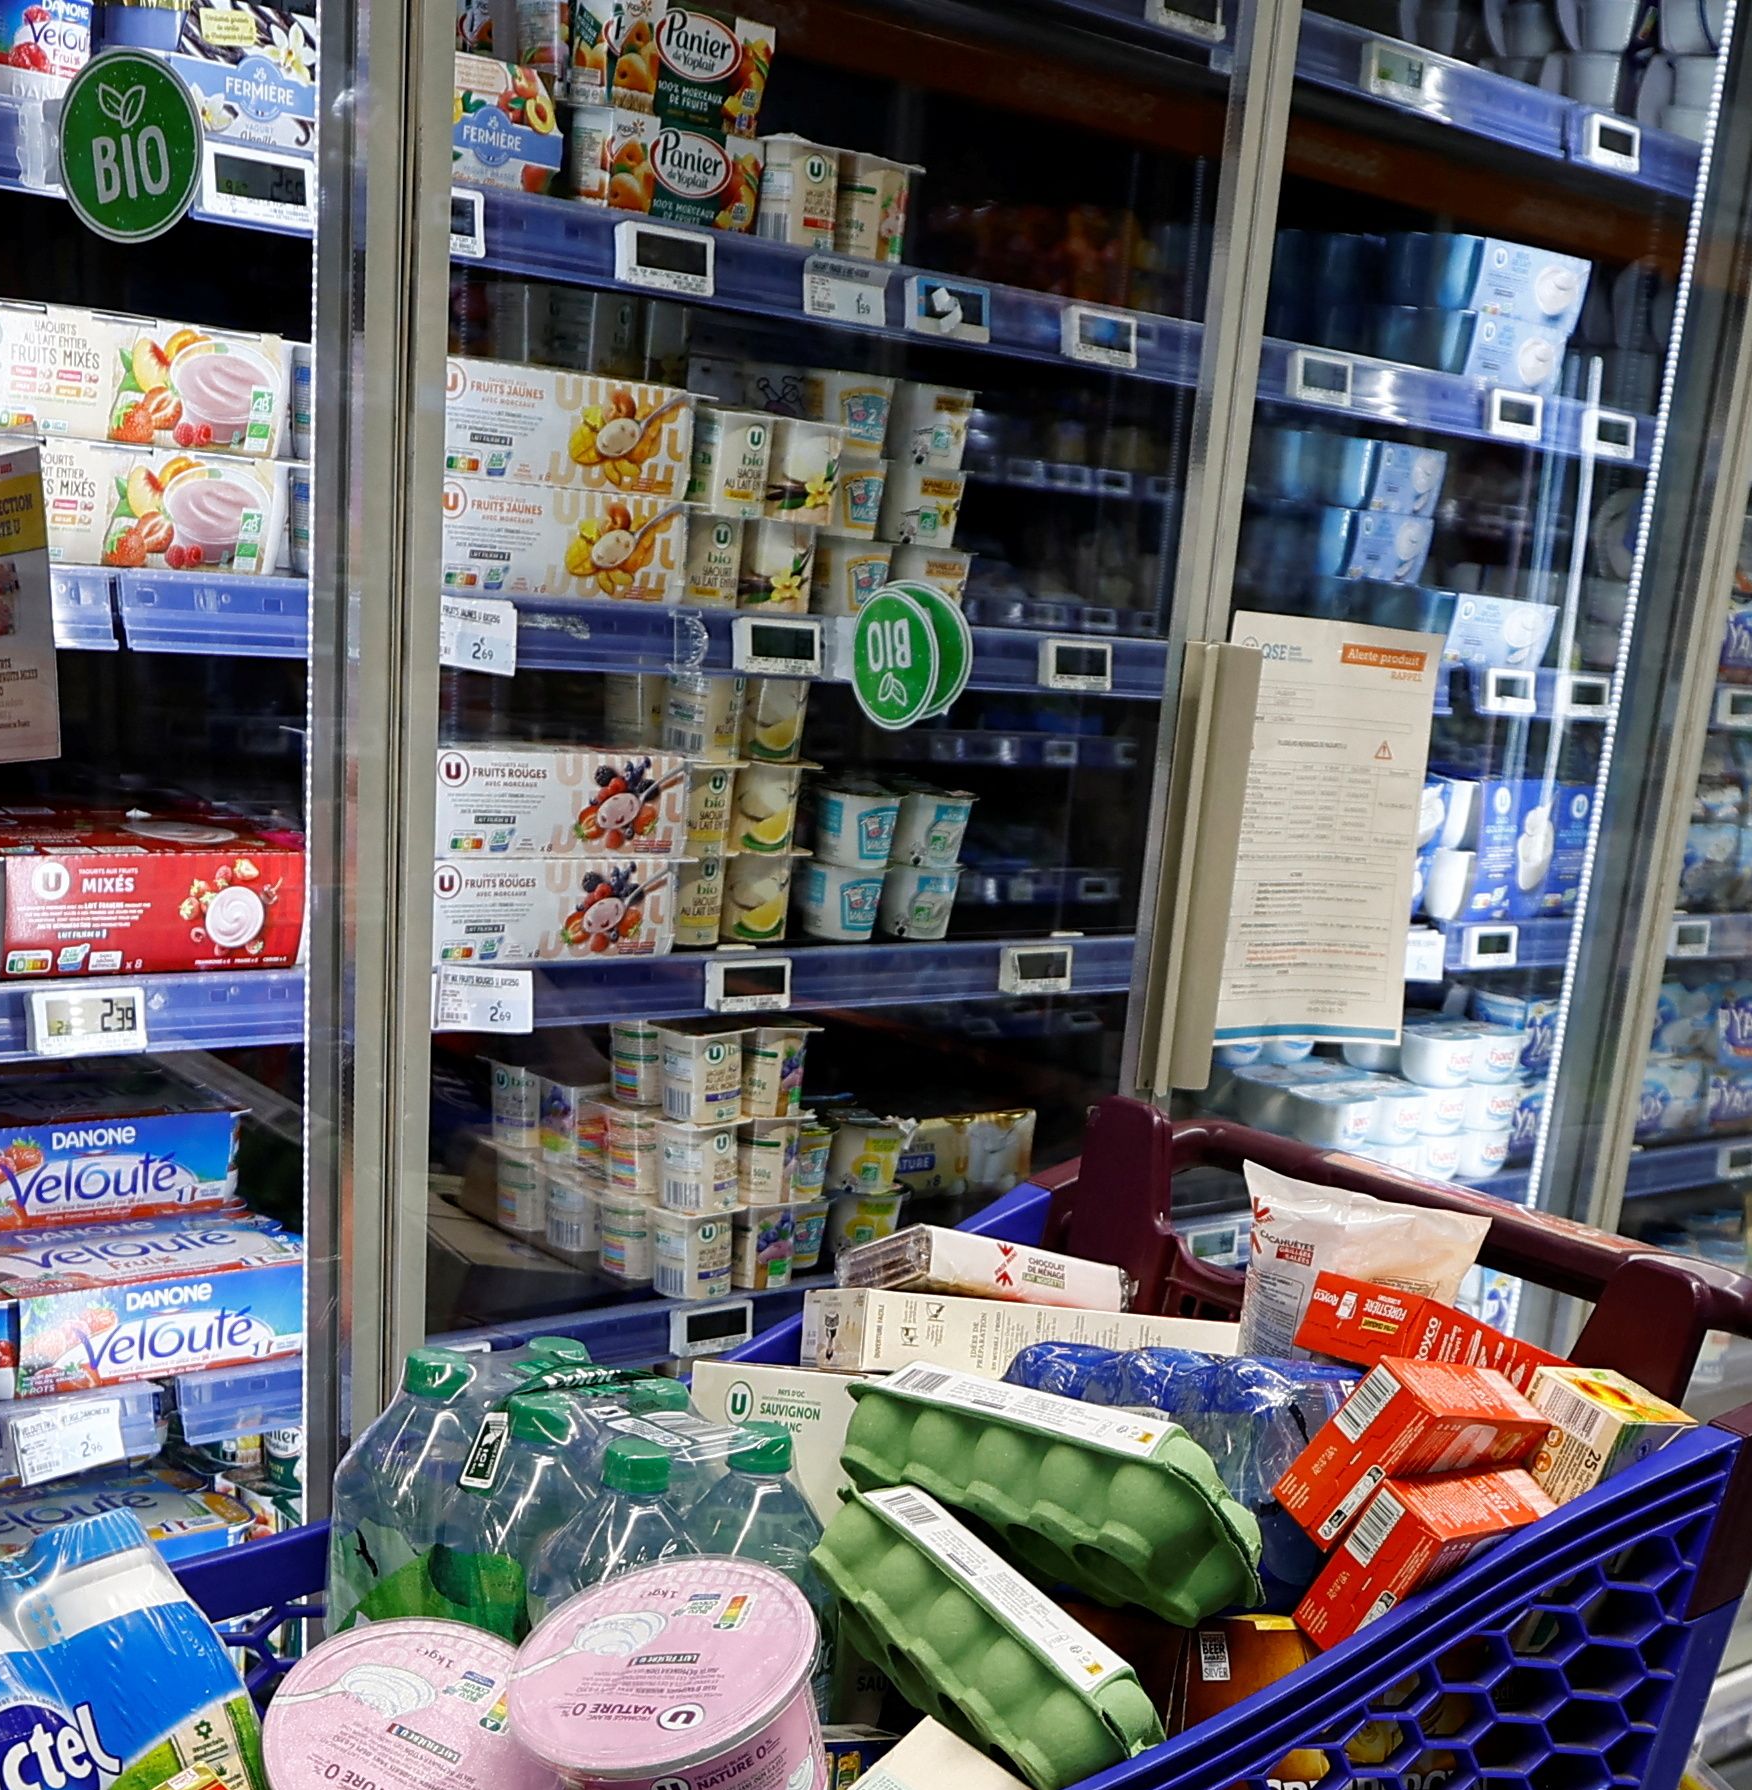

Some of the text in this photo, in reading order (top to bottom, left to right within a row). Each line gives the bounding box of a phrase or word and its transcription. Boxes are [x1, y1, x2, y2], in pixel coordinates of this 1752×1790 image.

[668, 9, 731, 61] Panier
[225, 75, 295, 106] FERMIÈRE
[462, 124, 522, 151] FERMIÈRE
[662, 130, 722, 176] Panier
[91, 124, 170, 205] BIO
[11, 345, 101, 371] FRUITS MIXÉS
[470, 381, 545, 400] FRUITS JAUNES
[56, 466, 85, 480] ENTIER
[59, 479, 96, 499] MIXÉS
[471, 499, 543, 516] FRUITS JAUNES
[867, 616, 913, 670] BIO
[1348, 646, 1420, 668] Alerte produit
[1390, 670, 1423, 682] RAPPEL
[471, 766, 548, 781] FRUITS ROUGES
[82, 874, 135, 894] MIXÉS
[464, 876, 537, 891] FRUITS ROUGES
[51, 1125, 137, 1151] DANONE
[2, 1227, 237, 1272] Velouté
[1259, 1228, 1317, 1252] CACAHUÈTES
[1276, 1245, 1315, 1260] GRILLÉES
[1285, 1253, 1314, 1267] SALÉES
[1027, 1264, 1067, 1282] DE MÉNAGE
[1028, 1255, 1067, 1273] CHOCOLAT
[126, 1282, 213, 1311] DANONE
[1314, 1286, 1340, 1308] ROYCO
[1362, 1298, 1409, 1322] FORESTIÈRE
[80, 1305, 255, 1370] Velouté
[874, 1303, 887, 1360] OUVERTURE FACILE
[759, 1401, 822, 1422] SAUVIGNON
[1584, 1449, 1604, 1473] 25
[1202, 1642, 1226, 1656] BEER
[1204, 1666, 1230, 1680] SILVER
